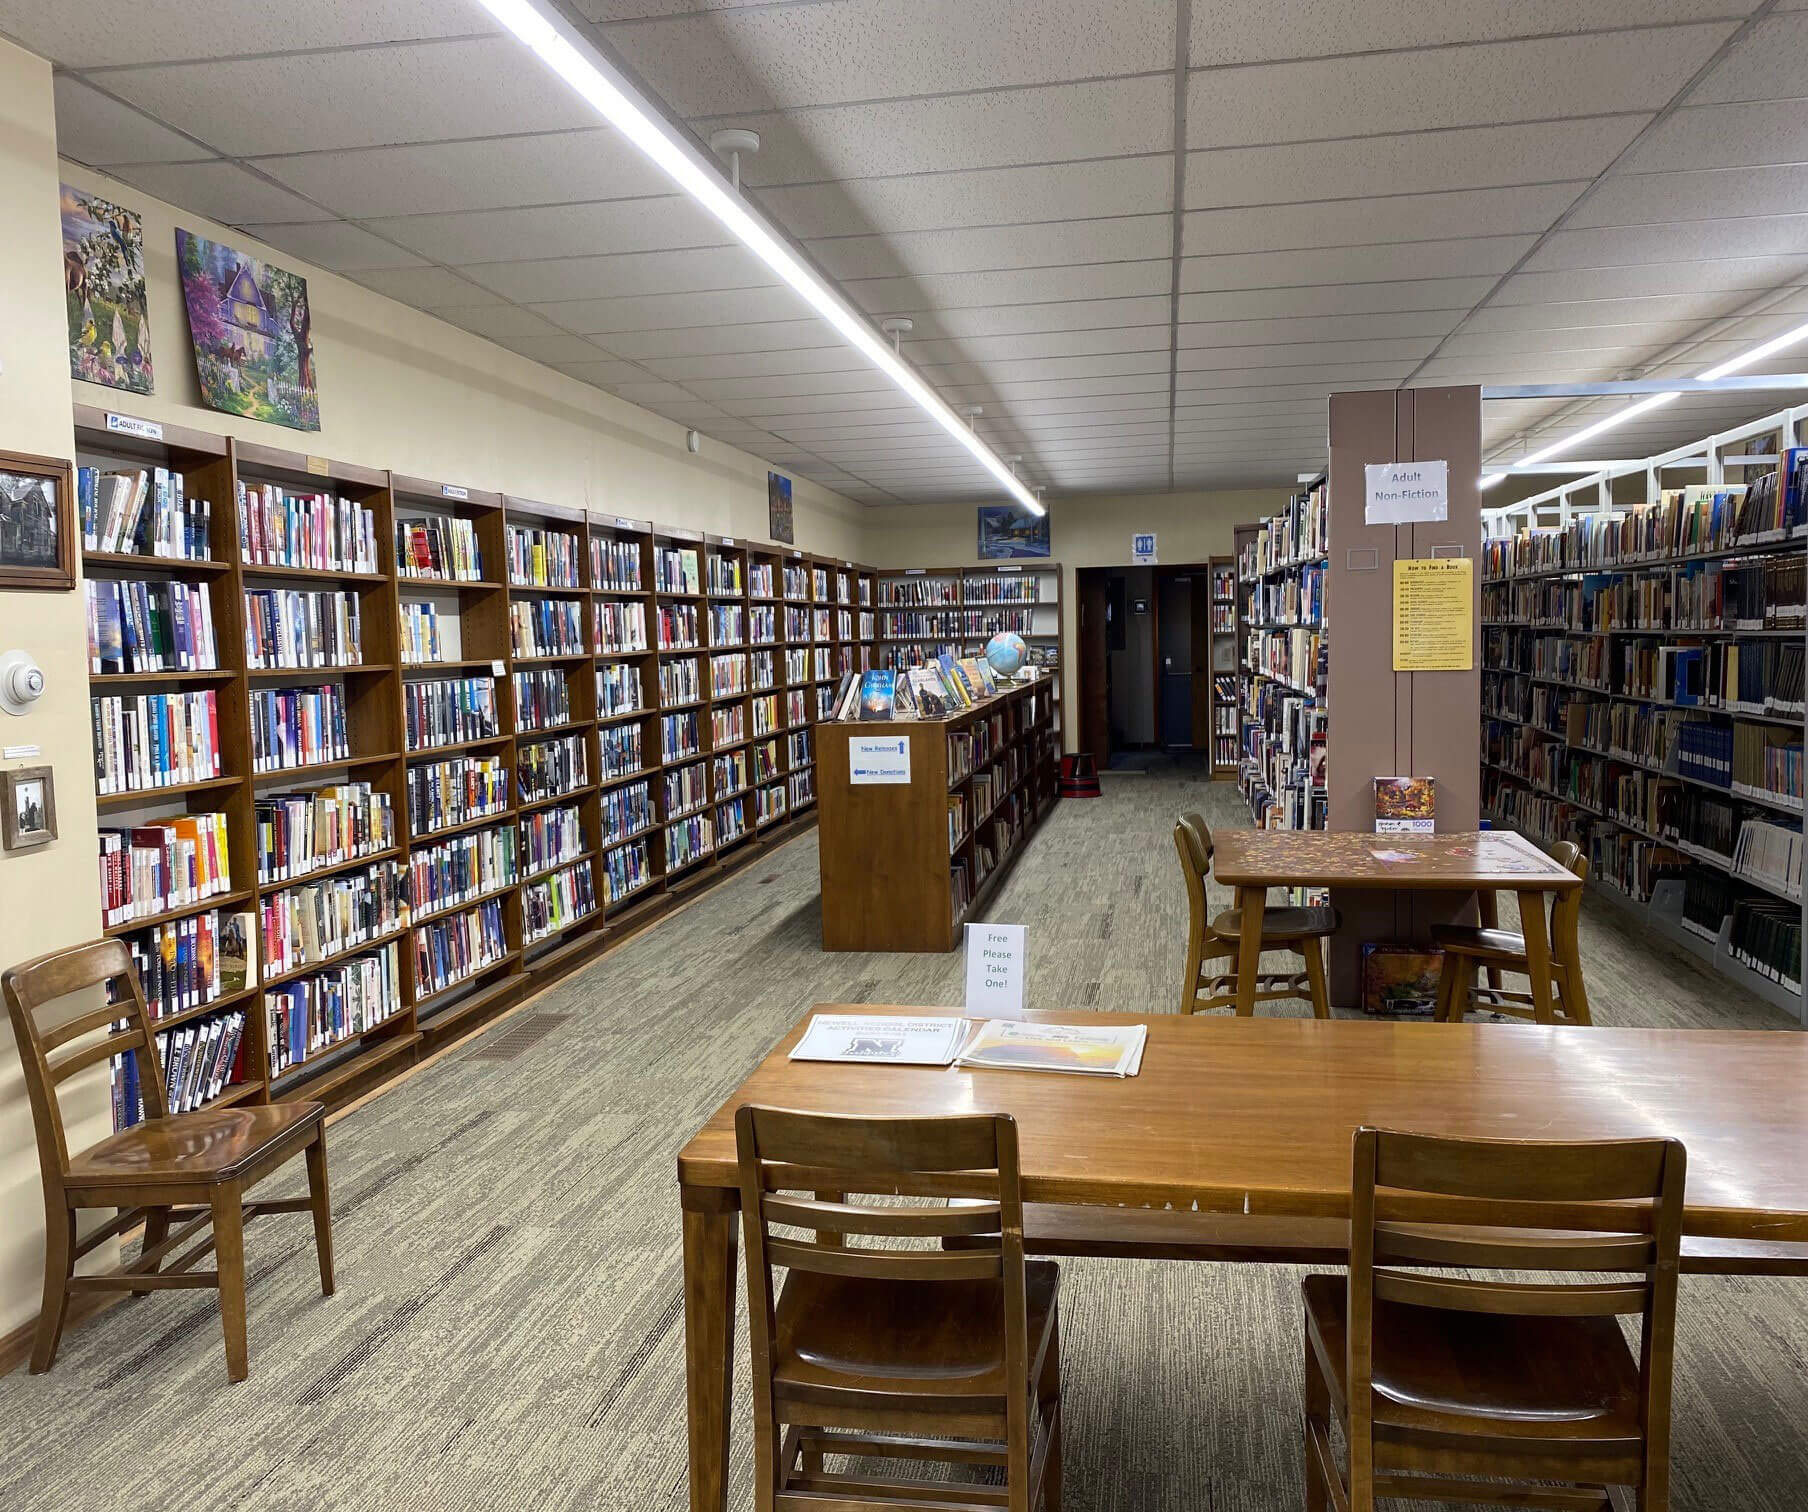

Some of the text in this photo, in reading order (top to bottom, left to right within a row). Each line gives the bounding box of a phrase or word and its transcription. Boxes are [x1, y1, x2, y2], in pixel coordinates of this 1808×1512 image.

[1392, 472, 1421, 482] Adult
[1376, 488, 1439, 501] Non-Fiction
[988, 933, 1008, 943] Free
[983, 949, 1012, 959] Please
[986, 964, 1008, 973] Take
[985, 979, 1008, 988] One!
